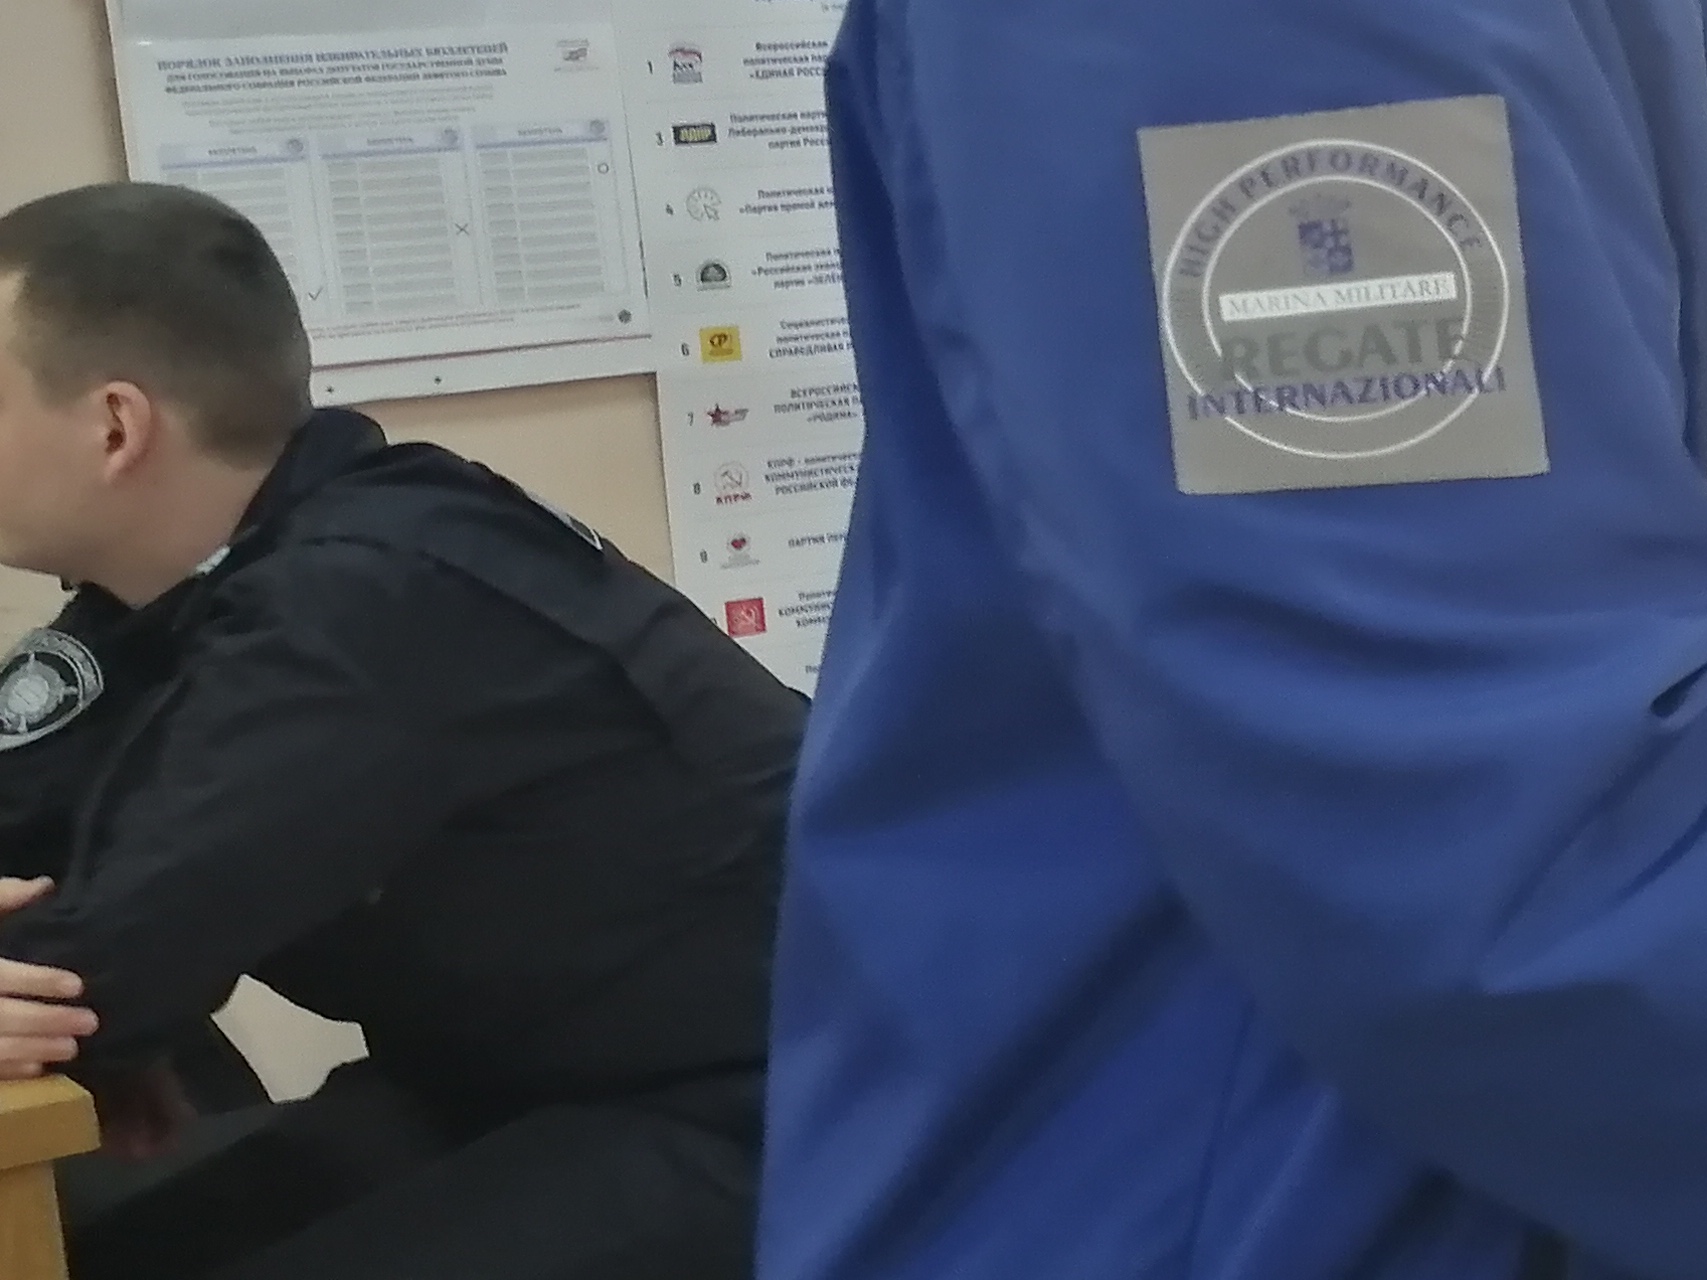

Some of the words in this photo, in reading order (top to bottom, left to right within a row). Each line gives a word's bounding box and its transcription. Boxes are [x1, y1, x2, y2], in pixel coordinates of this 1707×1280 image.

[1238, 150, 1483, 250] PERFORMANCE
[1178, 199, 1237, 278] HIGH
[1228, 284, 1326, 316] MARINA
[1333, 275, 1452, 310] MILITARE
[1221, 320, 1466, 381] REGATE
[1187, 366, 1508, 420] INTERNAZIONALI
